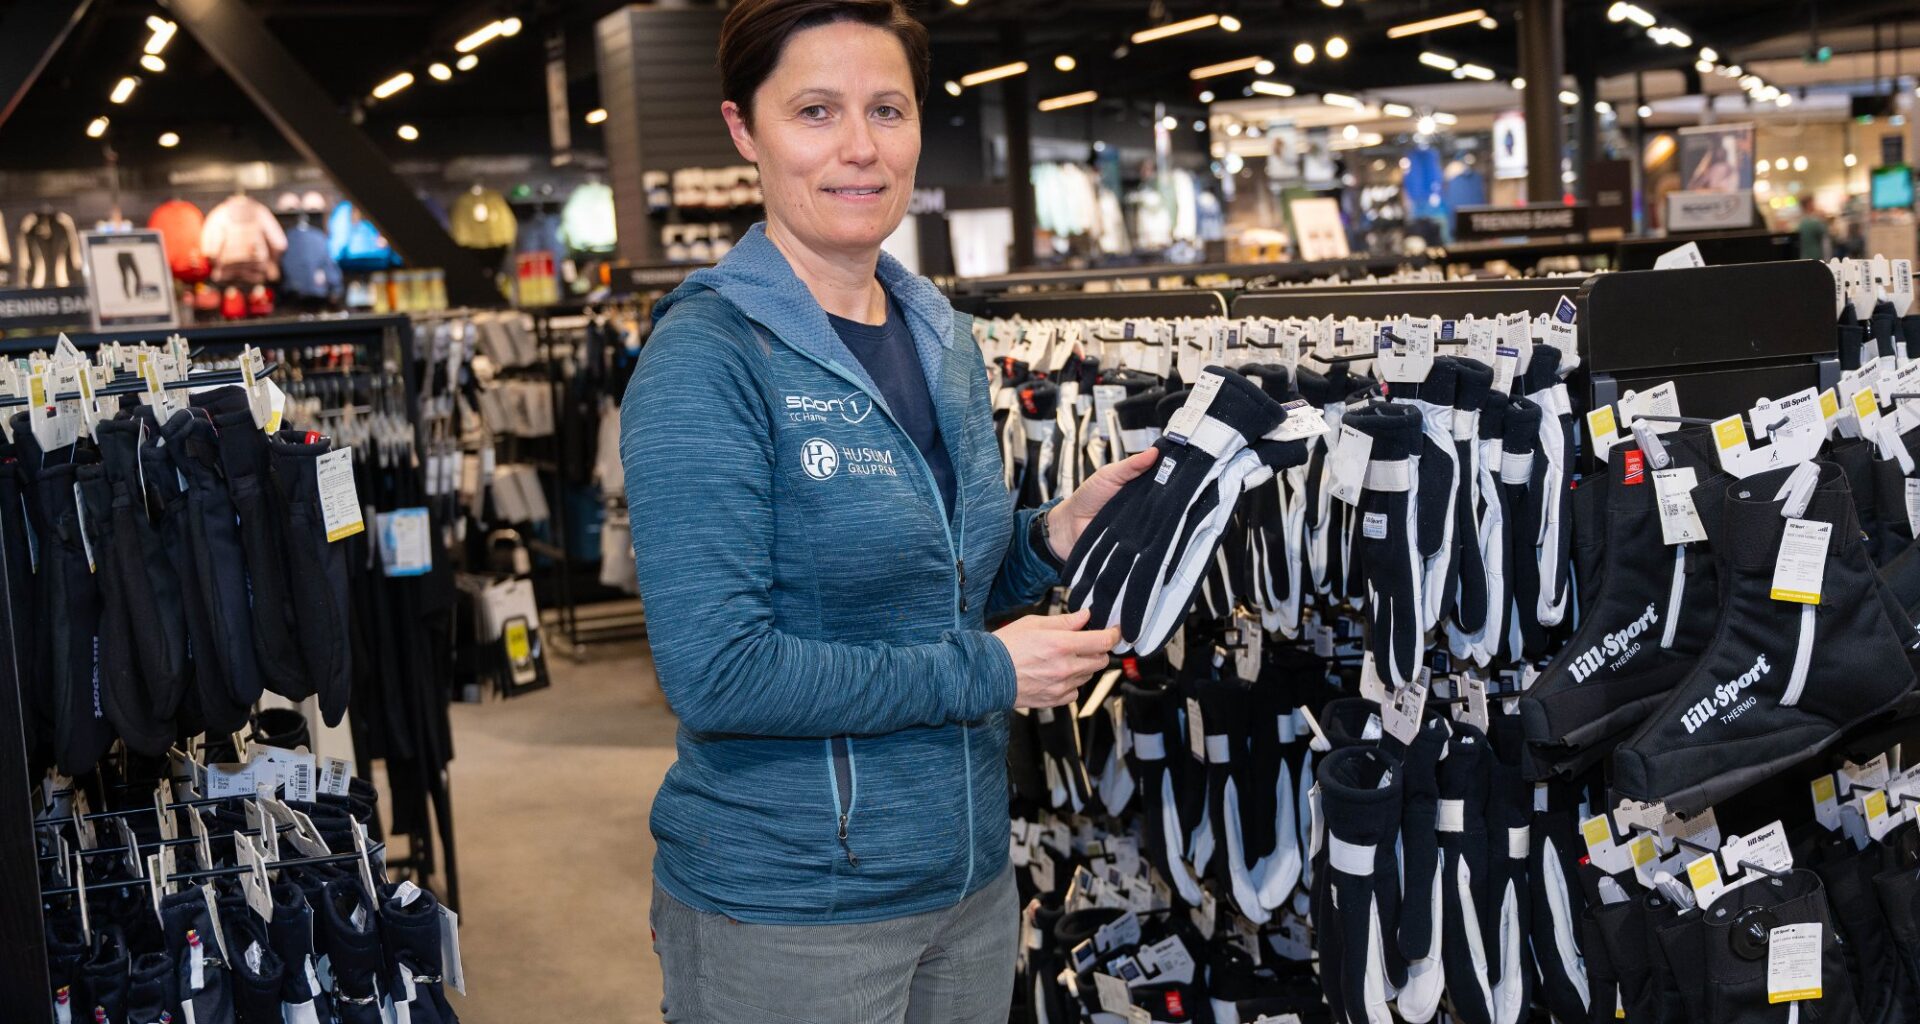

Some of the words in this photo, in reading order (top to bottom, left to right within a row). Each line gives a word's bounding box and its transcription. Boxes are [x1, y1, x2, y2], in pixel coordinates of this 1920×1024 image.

[842, 446, 893, 465] HUSUM
[847, 462, 898, 477] GRUPPEN
[1609, 642, 1641, 672] THERMO
[1720, 696, 1757, 725] THERMO
